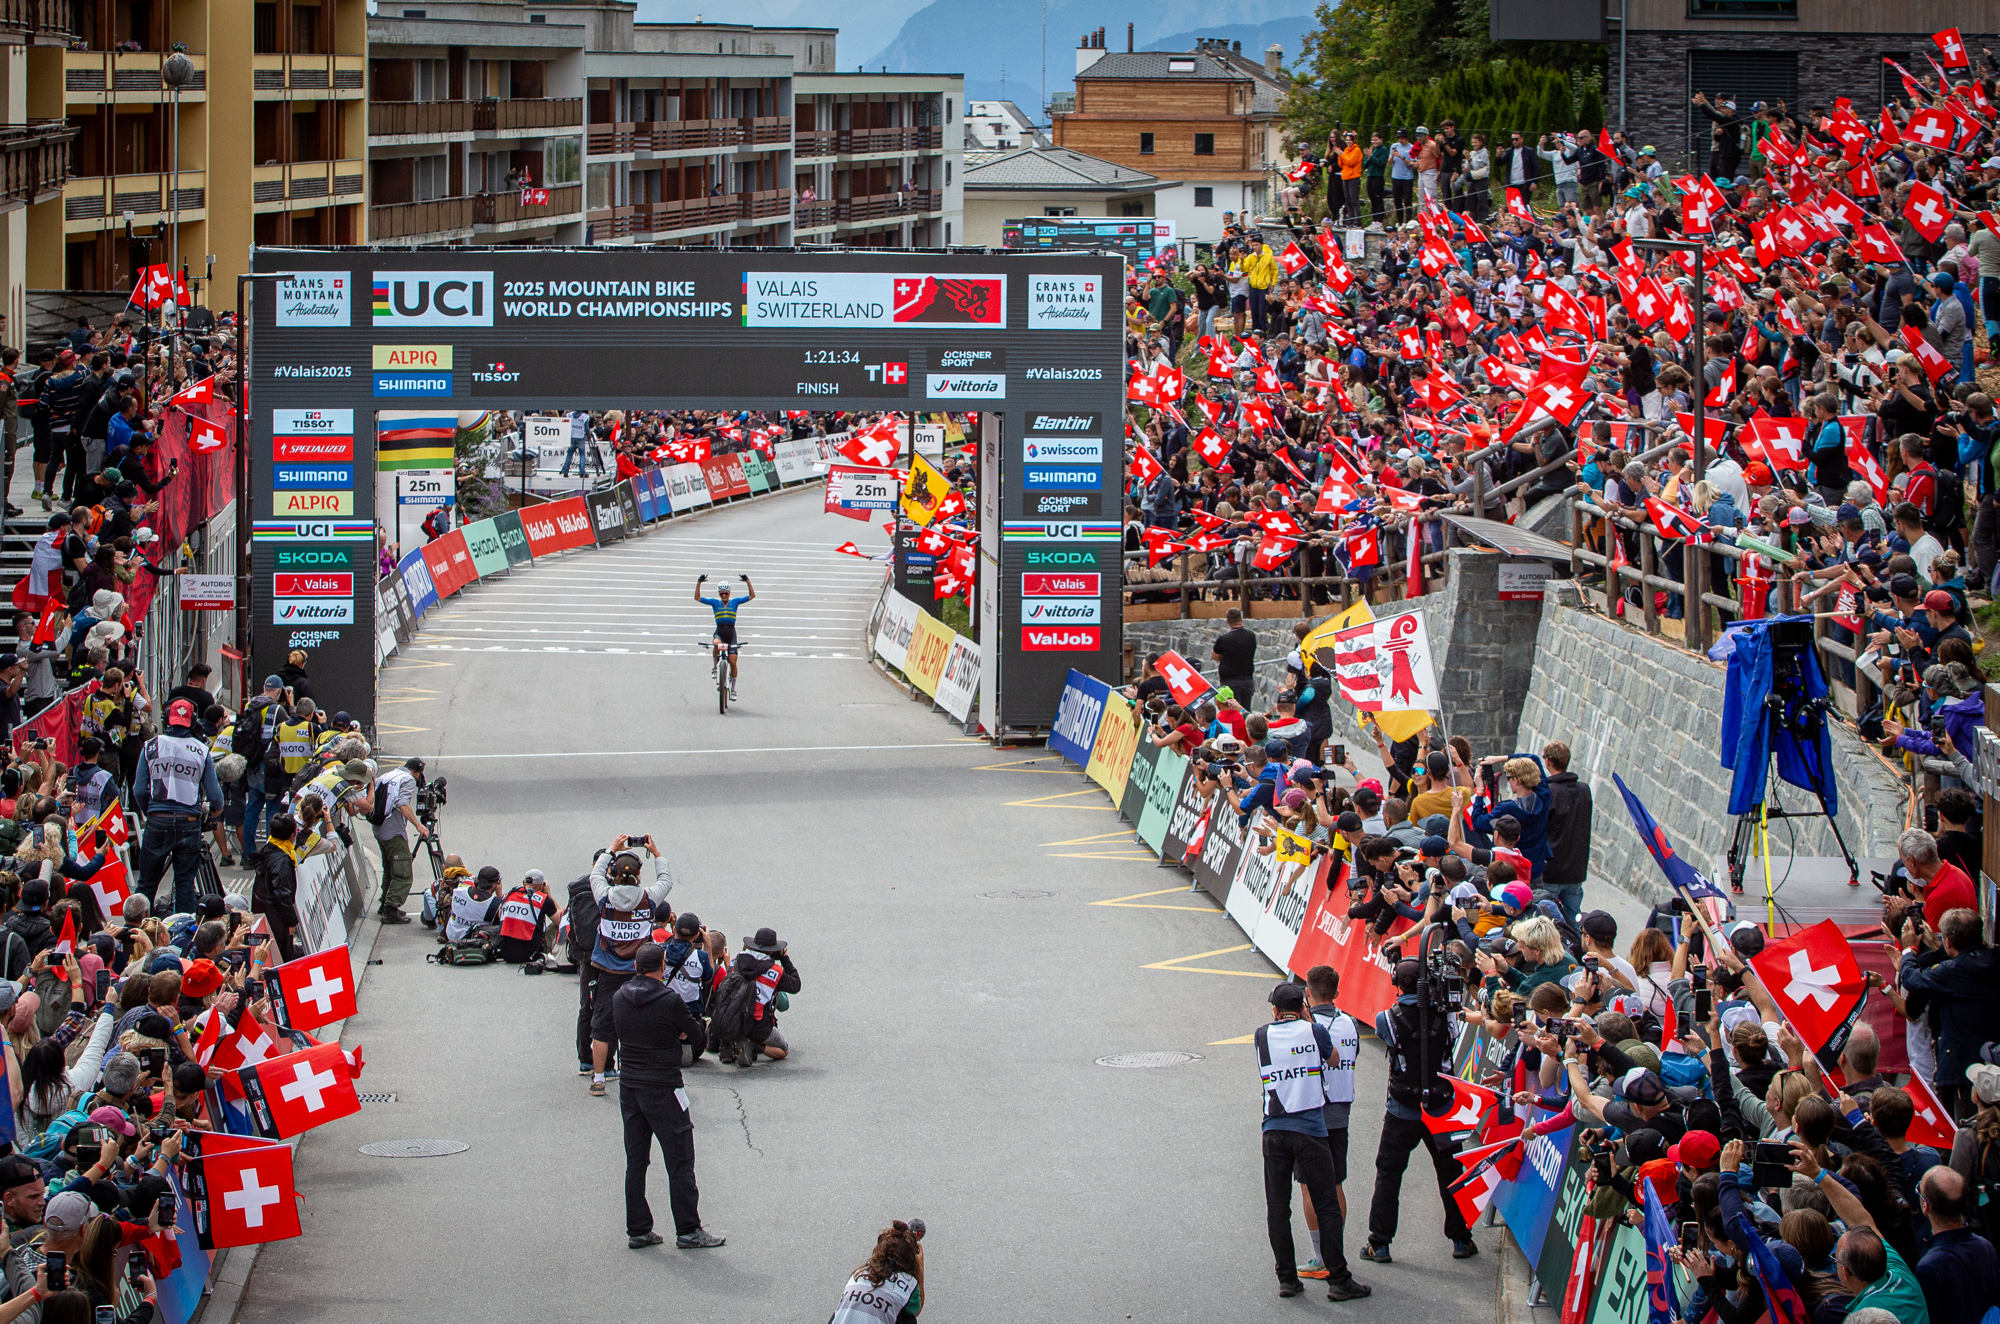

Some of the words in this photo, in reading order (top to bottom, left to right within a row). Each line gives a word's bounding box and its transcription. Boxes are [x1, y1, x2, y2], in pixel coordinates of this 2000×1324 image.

[284, 279, 324, 288] CRANS
[504, 282, 544, 297] 2025
[549, 282, 652, 297] MOUNTAIN
[656, 282, 696, 297] BIKE
[756, 280, 818, 297] VALAIS
[1036, 282, 1076, 292] CRANS
[284, 290, 344, 300] MONTANA
[393, 281, 483, 317] UCI
[1036, 293, 1094, 304] MONTANA
[286, 302, 340, 319] Absolutely
[504, 302, 572, 317] WORLD
[576, 302, 732, 318] CHAMPIONSHIPS
[756, 302, 884, 319] SWITZERLAND
[1037, 305, 1090, 322] Absolutely
[388, 350, 438, 367] ALPIQ
[804, 351, 860, 364] 1:21:34
[944, 350, 992, 360] OCHSNER
[941, 358, 974, 367] SPORT
[274, 365, 352, 379] #Valais2025
[472, 372, 520, 382] TISSOT
[1026, 368, 1102, 381] #Valais2025
[378, 378, 446, 390] SHIMANO
[797, 382, 839, 394] FINISH
[950, 380, 998, 392] vittoria
[292, 420, 334, 428] TISSOT
[1033, 416, 1094, 431] Santini
[534, 426, 560, 436] 50m
[289, 444, 346, 453] SPECIALIZED
[1041, 444, 1098, 456] swisscom
[279, 472, 348, 482] SHIMANO
[1029, 472, 1096, 483] SHIMANO
[410, 480, 440, 492] 25m
[855, 484, 887, 496] 25m
[288, 496, 340, 512] ALPIQ
[404, 496, 446, 504] SHIMANO
[1041, 496, 1088, 505] OCHSNER
[1038, 504, 1070, 513] SPORT
[556, 512, 588, 534] ValJob
[297, 524, 330, 537] UCI
[526, 518, 556, 542] ValJob
[1046, 525, 1078, 537] UCI
[304, 578, 338, 590] Valais
[1052, 578, 1086, 590] Valais
[297, 606, 348, 618] vittoria
[1046, 606, 1095, 618] vittoria
[292, 632, 340, 640] OCHSNER
[1028, 632, 1093, 646] ValJob
[288, 640, 322, 648] SPORT
[1053, 684, 1102, 751] SHIMANO
[154, 762, 168, 774] TV
[1202, 832, 1232, 876] SPORT
[611, 922, 641, 930] VIDEO
[611, 931, 640, 940] RADIO
[1296, 1044, 1316, 1054] UCI
[1270, 1066, 1306, 1082] STAFF
[850, 1290, 893, 1314] HOST
